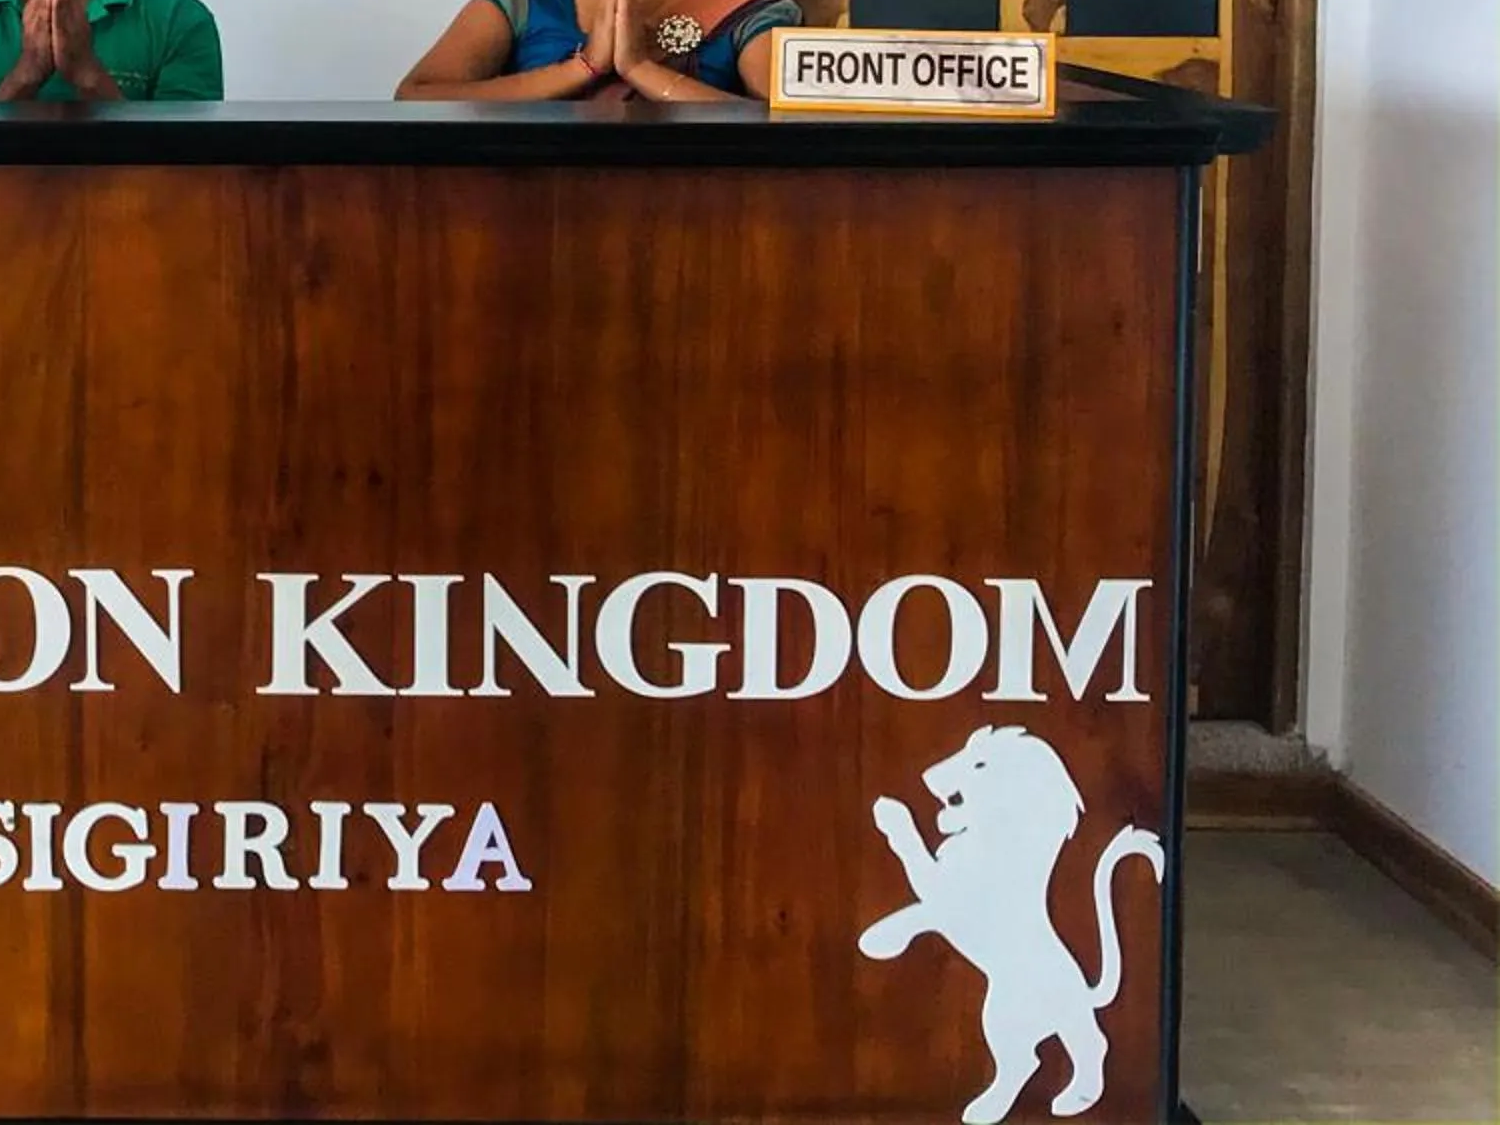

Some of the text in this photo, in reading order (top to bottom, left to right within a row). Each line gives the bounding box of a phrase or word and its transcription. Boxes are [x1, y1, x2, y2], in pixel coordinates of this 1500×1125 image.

[797, 50, 1029, 89] FRONT OFFICE
[255, 571, 1153, 702] KINGDOM
